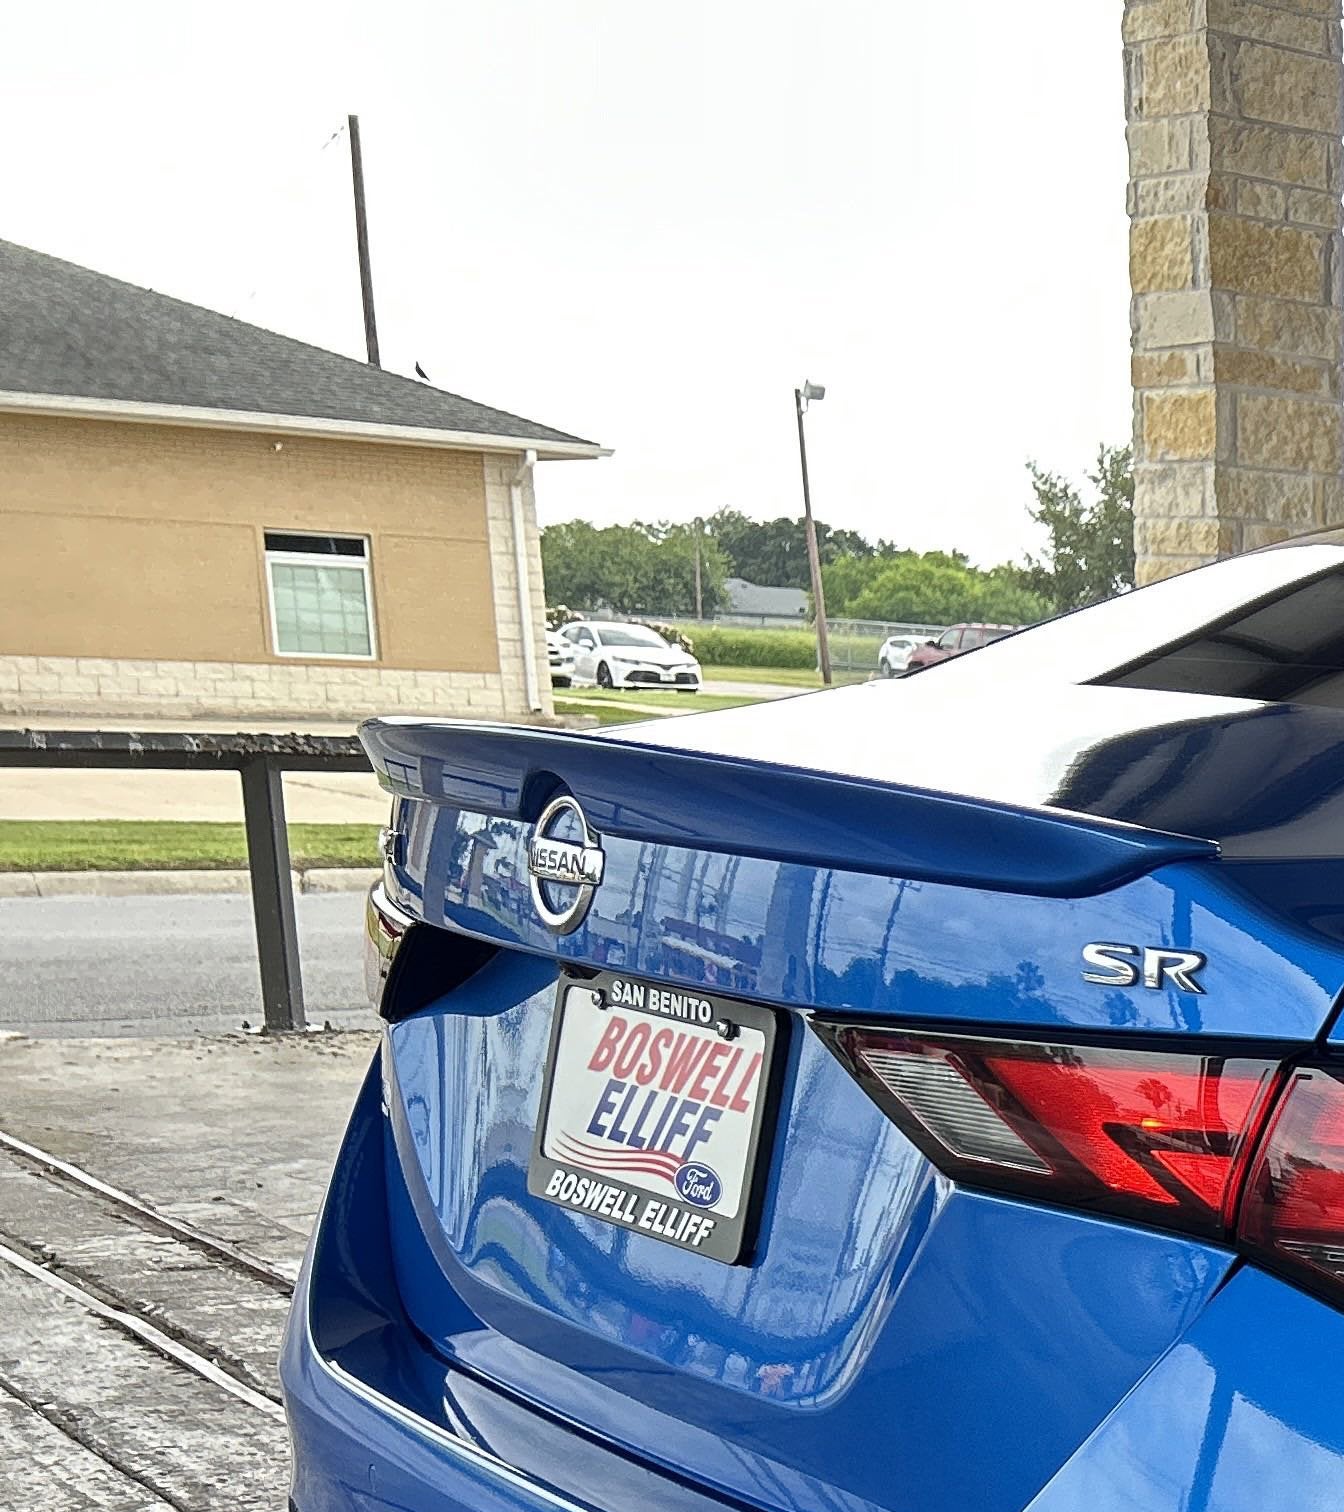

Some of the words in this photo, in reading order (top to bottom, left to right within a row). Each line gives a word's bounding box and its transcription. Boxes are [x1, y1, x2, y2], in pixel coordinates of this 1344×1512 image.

[1080, 941, 1207, 994] SR
[612, 980, 645, 1007] SAN
[649, 988, 712, 1022] BENITO
[587, 1016, 763, 1113] BOSWELL
[586, 1078, 723, 1160] ELLIFF
[545, 1169, 638, 1223] BOSWELL
[639, 1201, 716, 1246] ELLIFF
[682, 1168, 715, 1202] Ford
